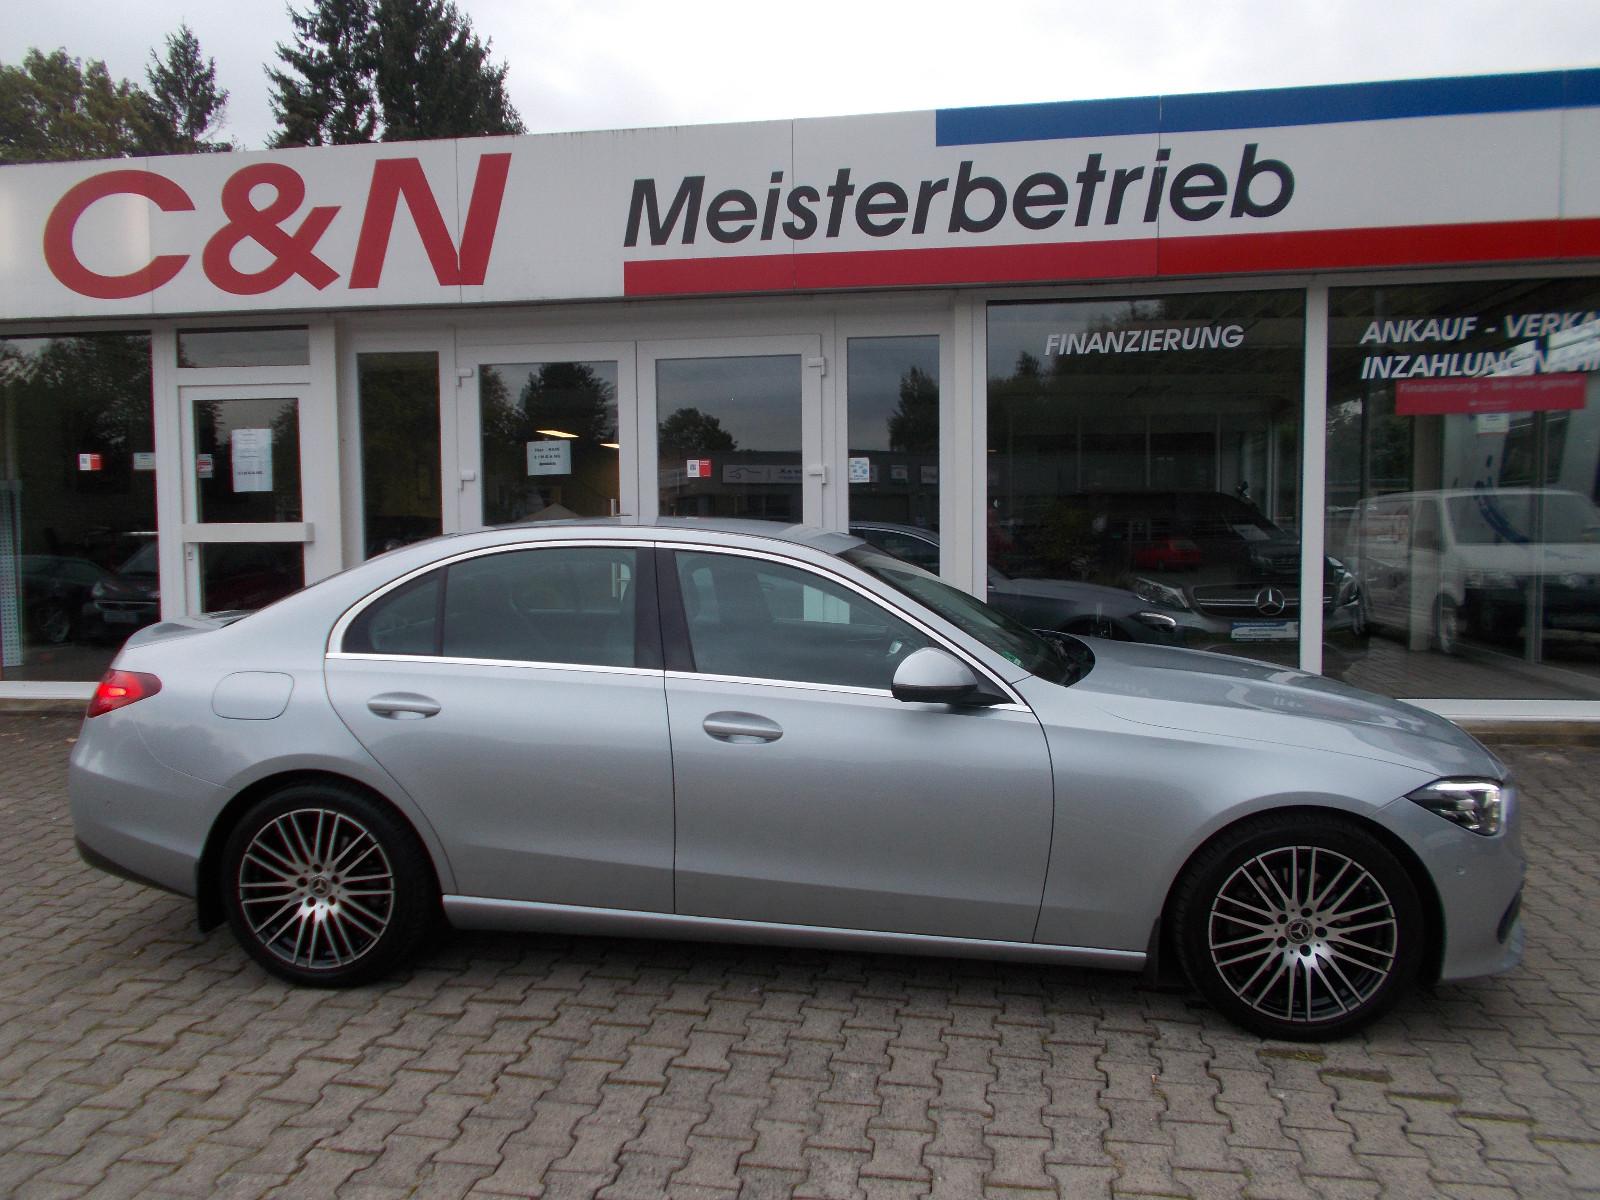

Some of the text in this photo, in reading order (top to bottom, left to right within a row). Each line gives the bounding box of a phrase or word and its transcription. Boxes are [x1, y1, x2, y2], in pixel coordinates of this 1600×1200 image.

[43, 153, 512, 299] C&N
[624, 143, 1295, 247] Meisterbetrieb
[1044, 324, 1245, 356] FINANZIERUNG
[1360, 316, 1478, 344] ANKAUF
